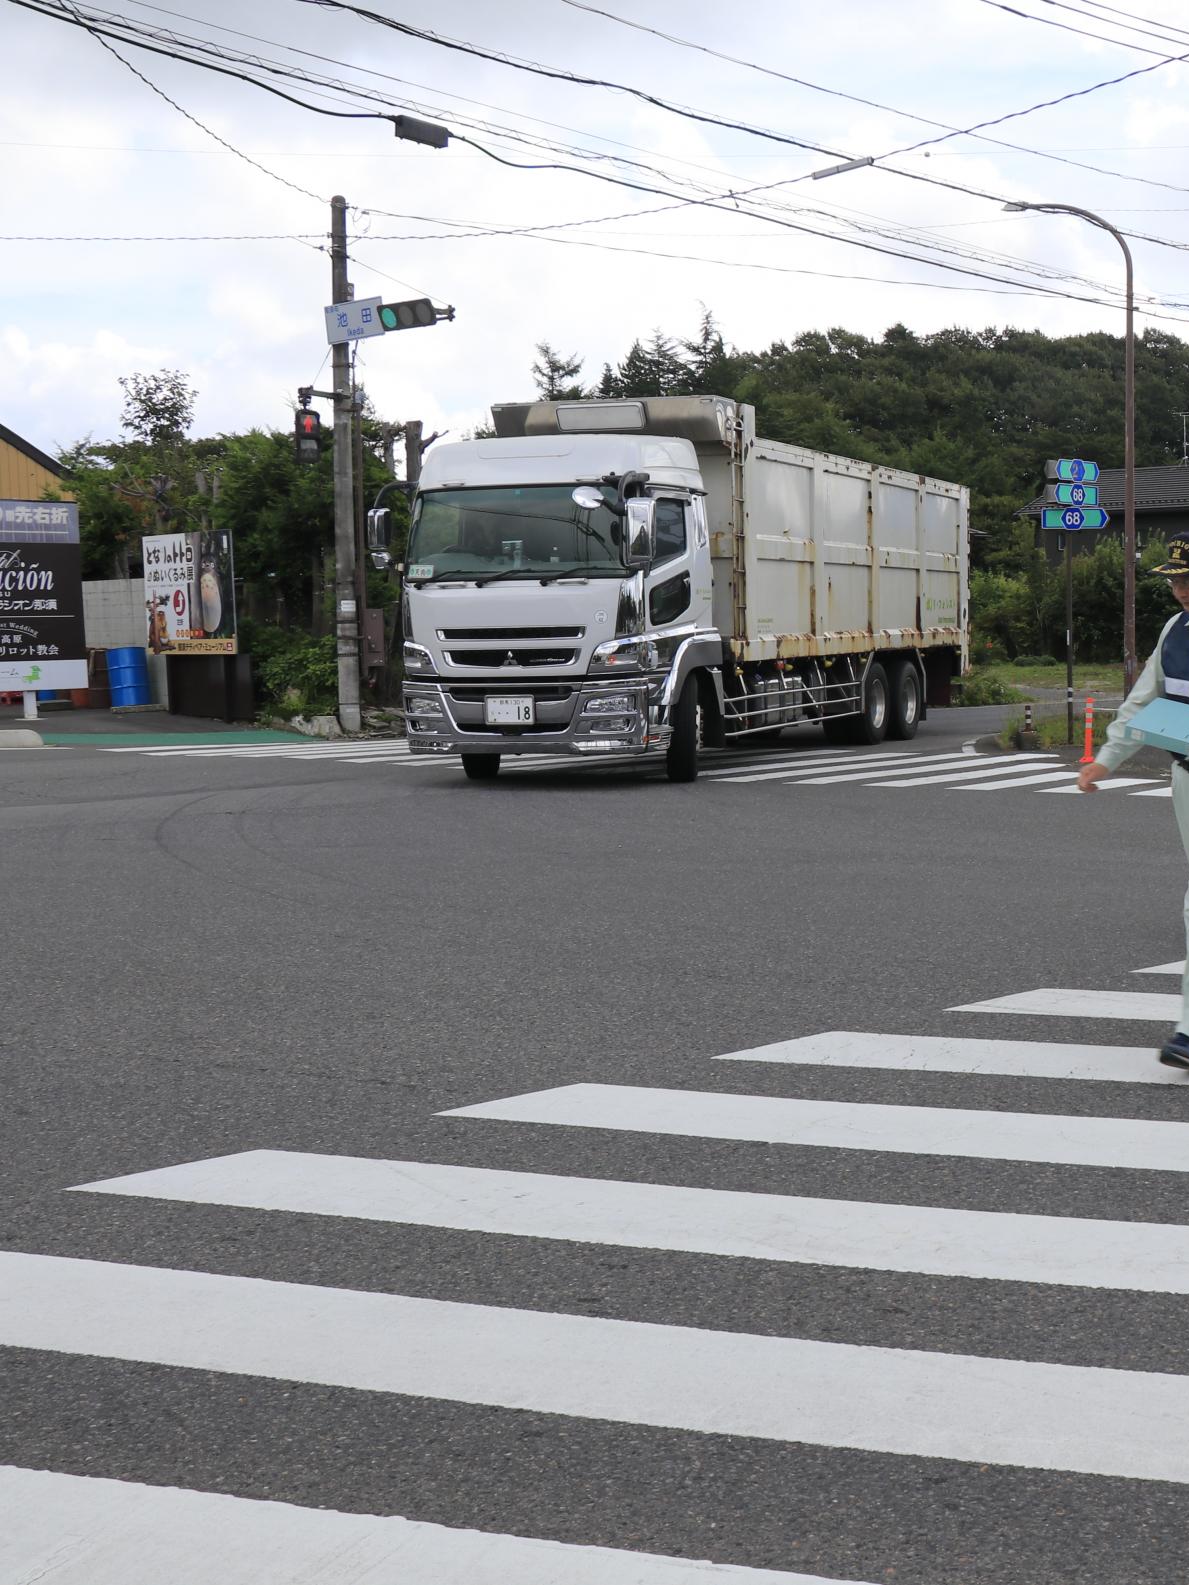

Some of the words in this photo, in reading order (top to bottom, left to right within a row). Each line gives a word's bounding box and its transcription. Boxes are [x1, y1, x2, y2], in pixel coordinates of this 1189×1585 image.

[347, 327, 364, 336] Ikeda
[1073, 488, 1083, 501] 68
[1065, 511, 1080, 525] 68
[9, 622, 39, 637] Wedding
[1, 634, 23, 644] 高原
[0, 644, 60, 656] リロット教会
